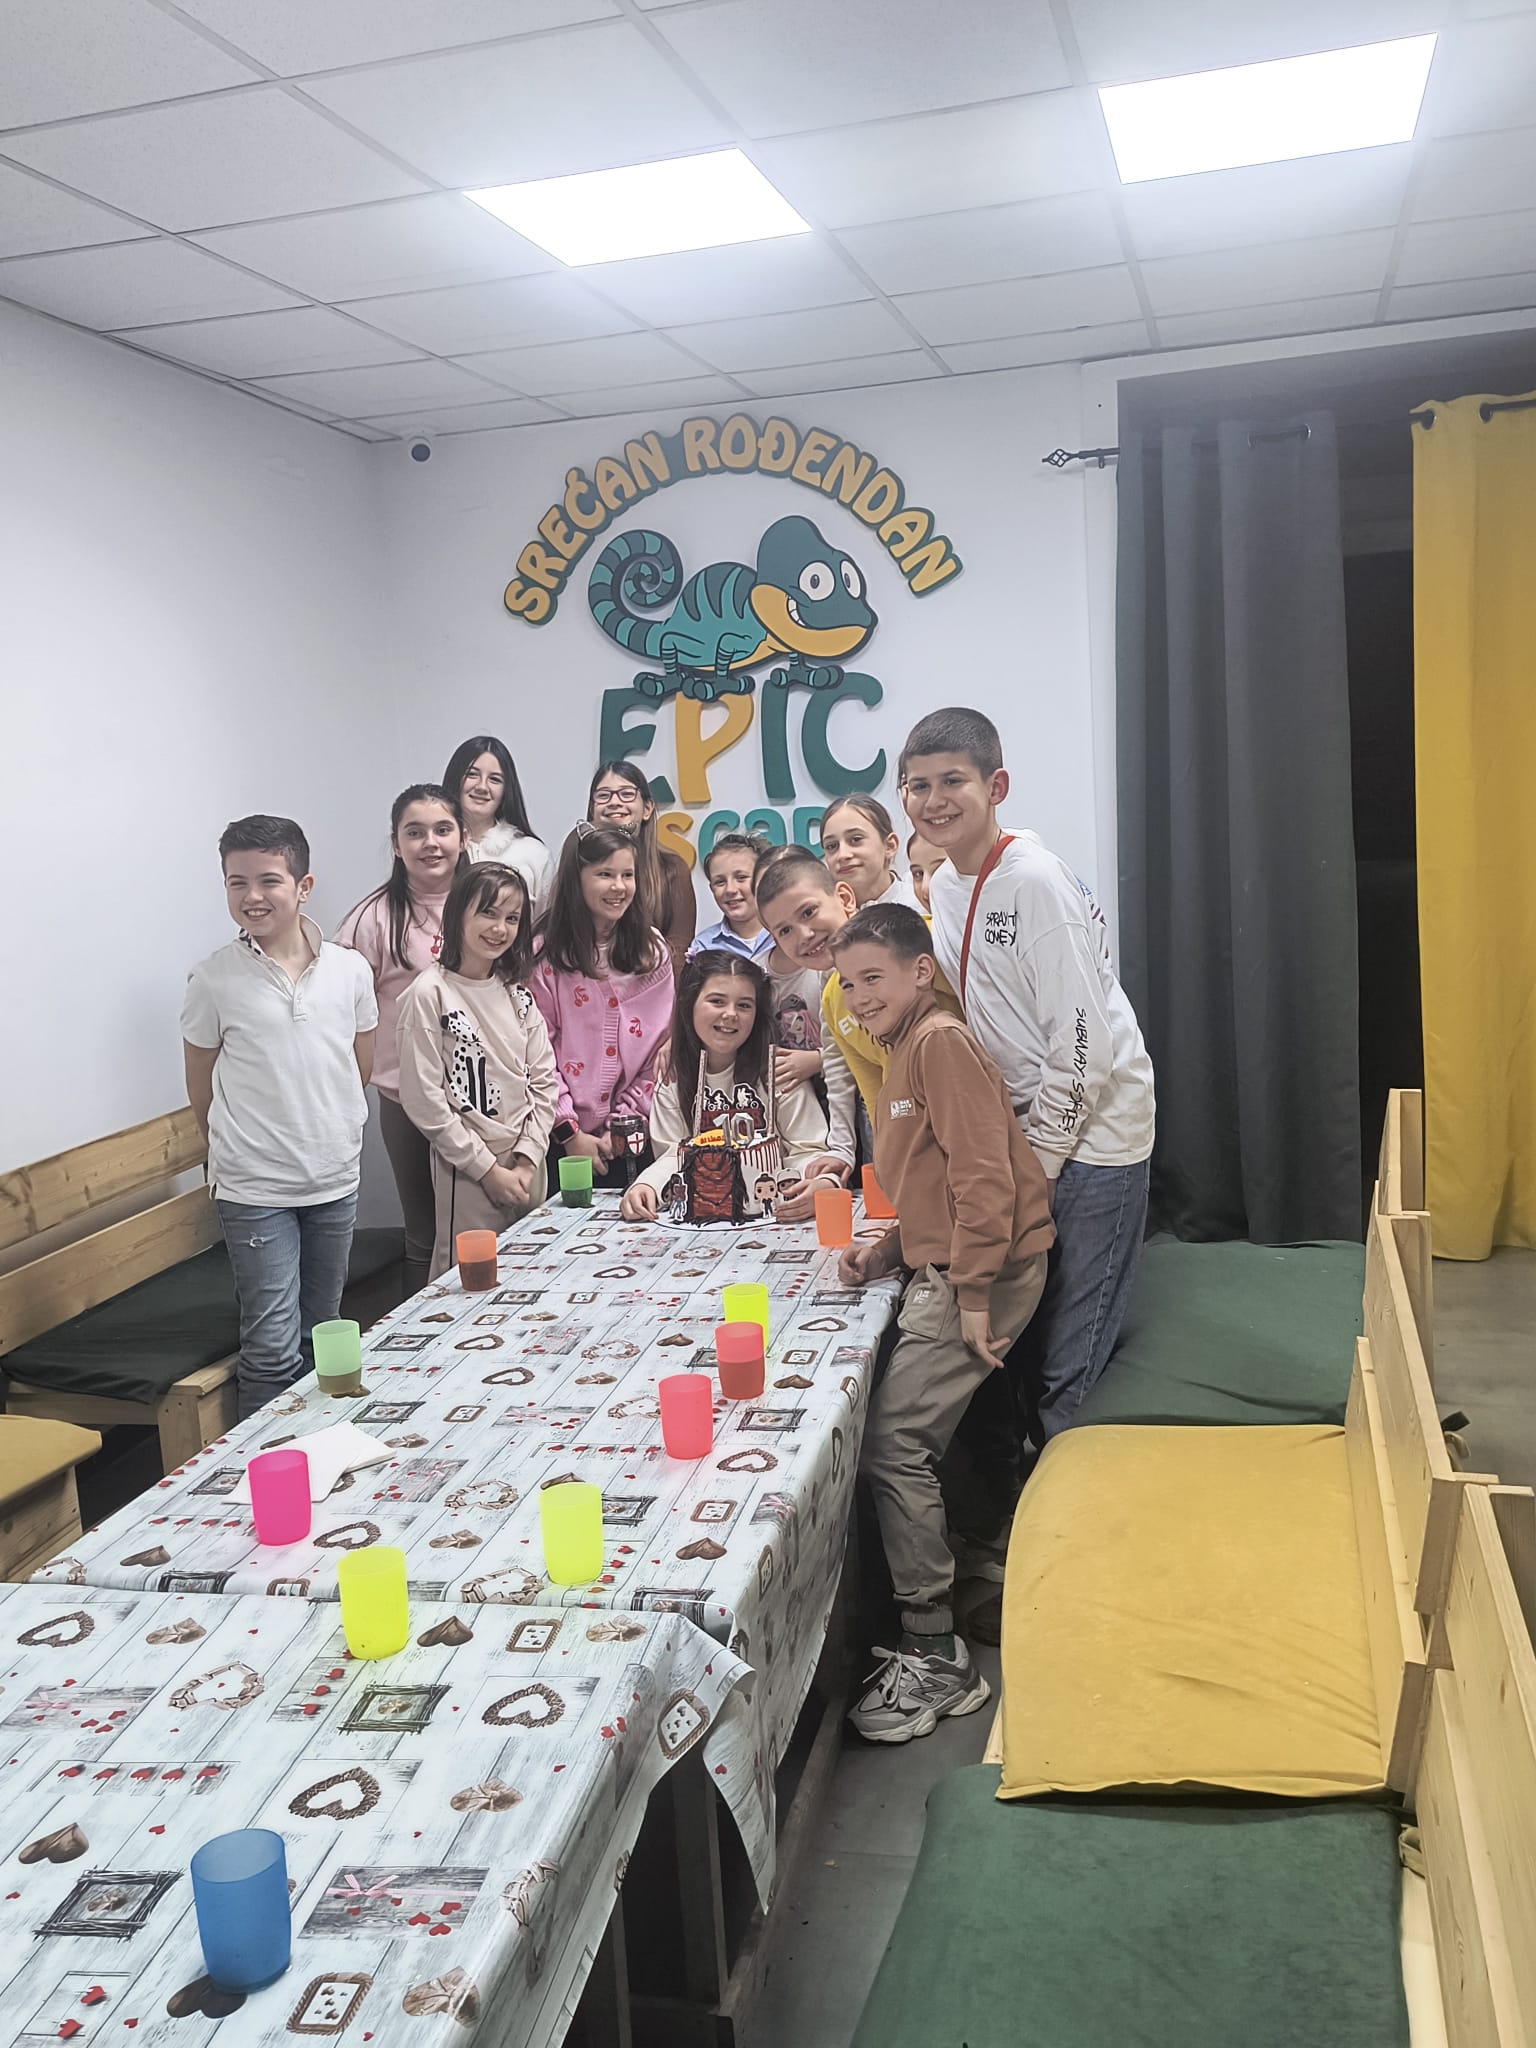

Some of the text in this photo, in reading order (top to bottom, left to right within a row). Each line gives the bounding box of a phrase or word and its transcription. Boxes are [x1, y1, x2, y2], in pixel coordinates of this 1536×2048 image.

[504, 412, 960, 623] SREĆAN ROĐENDAN
[599, 672, 887, 806] EPIC
[1073, 1007, 1088, 1078] SUBWAY
[713, 1113, 754, 1146] 10
